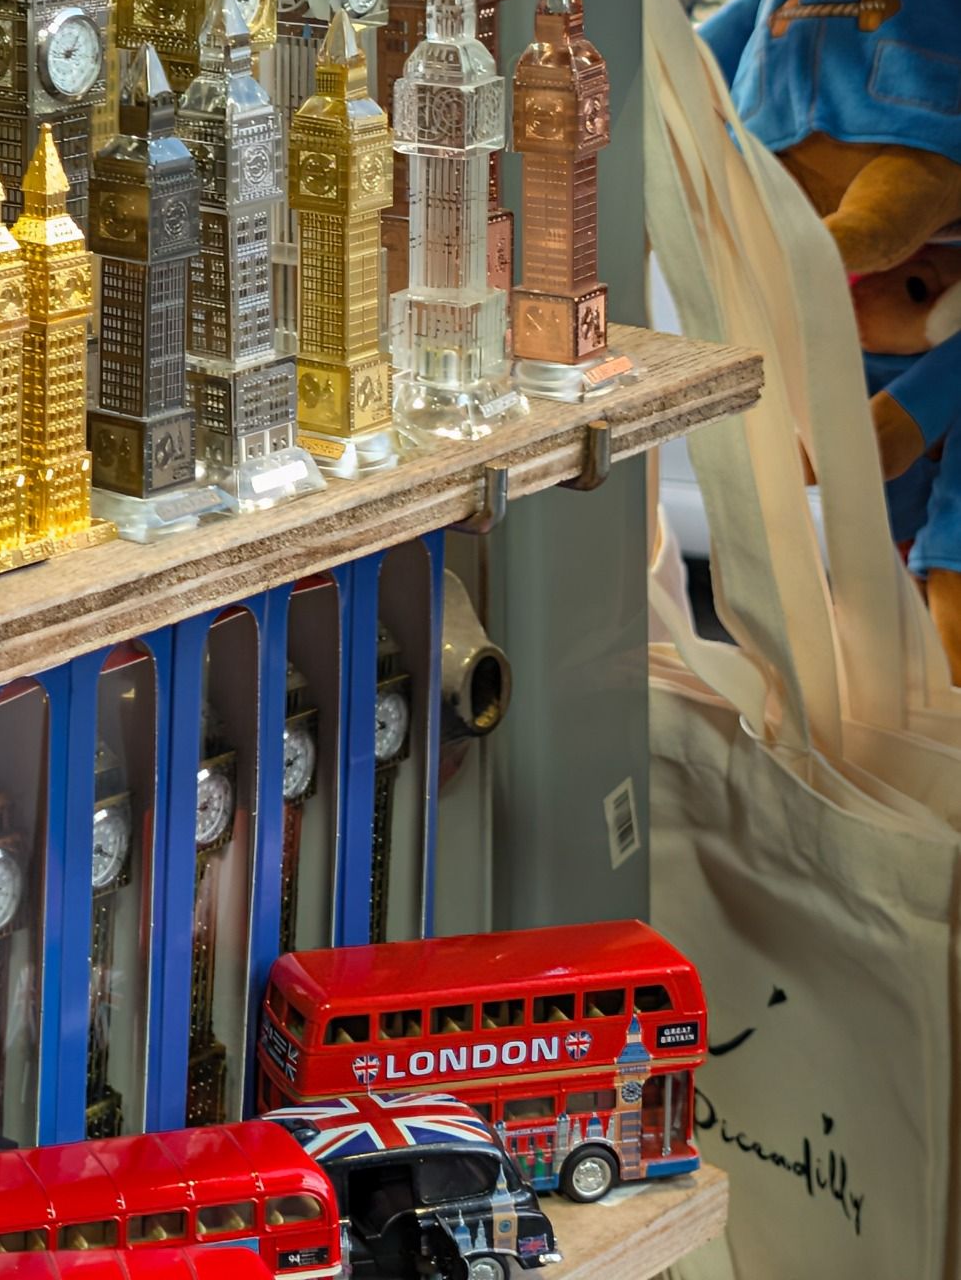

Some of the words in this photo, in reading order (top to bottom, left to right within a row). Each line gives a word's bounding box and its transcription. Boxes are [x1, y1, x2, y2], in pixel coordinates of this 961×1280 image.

[663, 1026, 691, 1036] GREAT
[660, 1034, 695, 1044] BRITAIN
[385, 1036, 559, 1080] LONDON
[288, 1254, 300, 1264] 94
